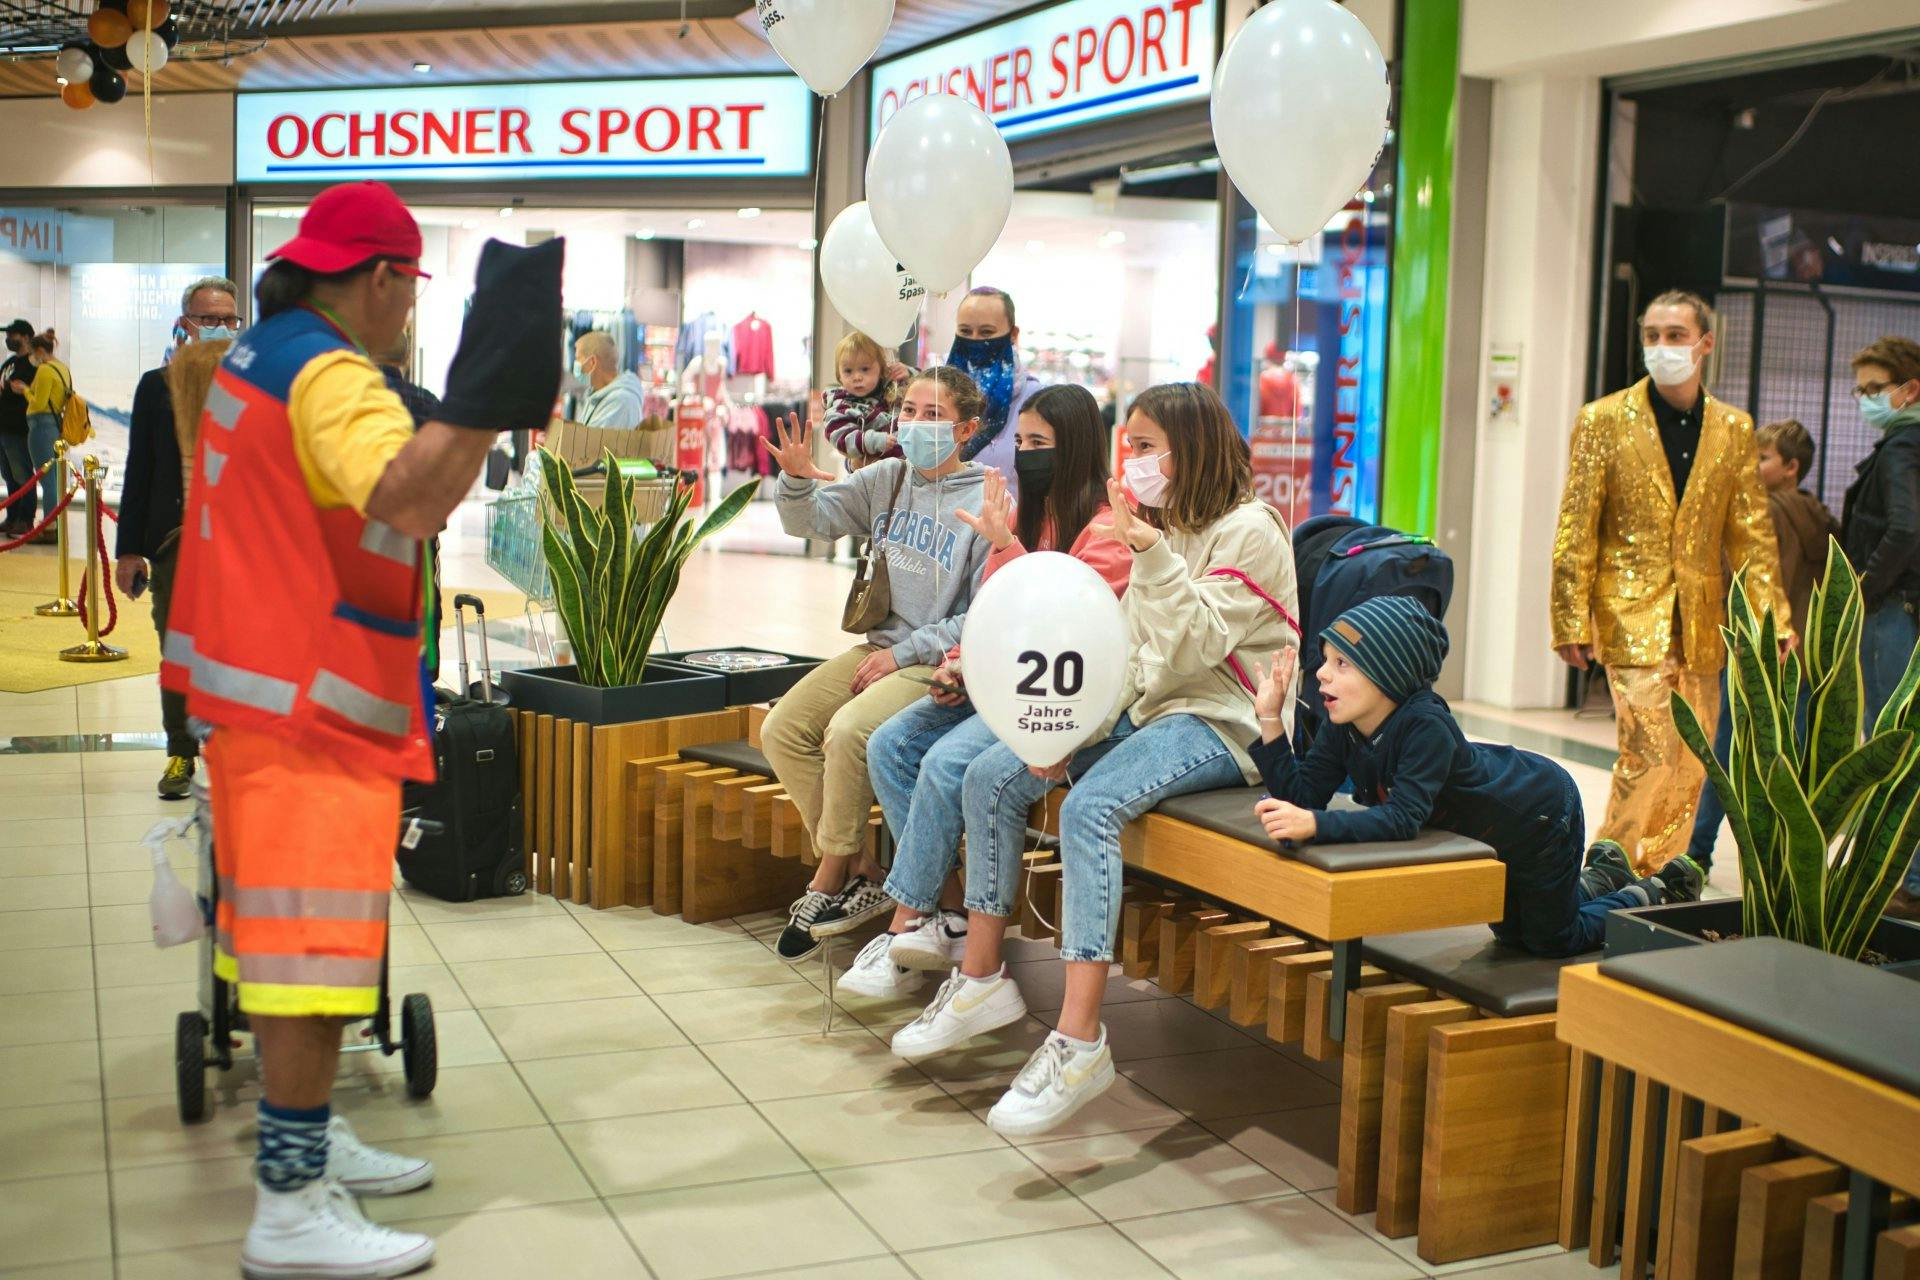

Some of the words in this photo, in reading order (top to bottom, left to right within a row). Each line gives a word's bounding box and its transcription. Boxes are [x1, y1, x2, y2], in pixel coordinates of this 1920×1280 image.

[879, 47, 1033, 131] OSNER
[1048, 0, 1204, 100] SPORT
[266, 109, 533, 159] OCHSNER
[559, 104, 765, 155] SPORT
[1329, 355, 1360, 516] SNER
[873, 508, 957, 573] GORGIA
[888, 547, 926, 575] Athletic
[1016, 650, 1083, 696] 20
[1018, 717, 1080, 733] Spass.
[1024, 704, 1073, 717] Jahre
